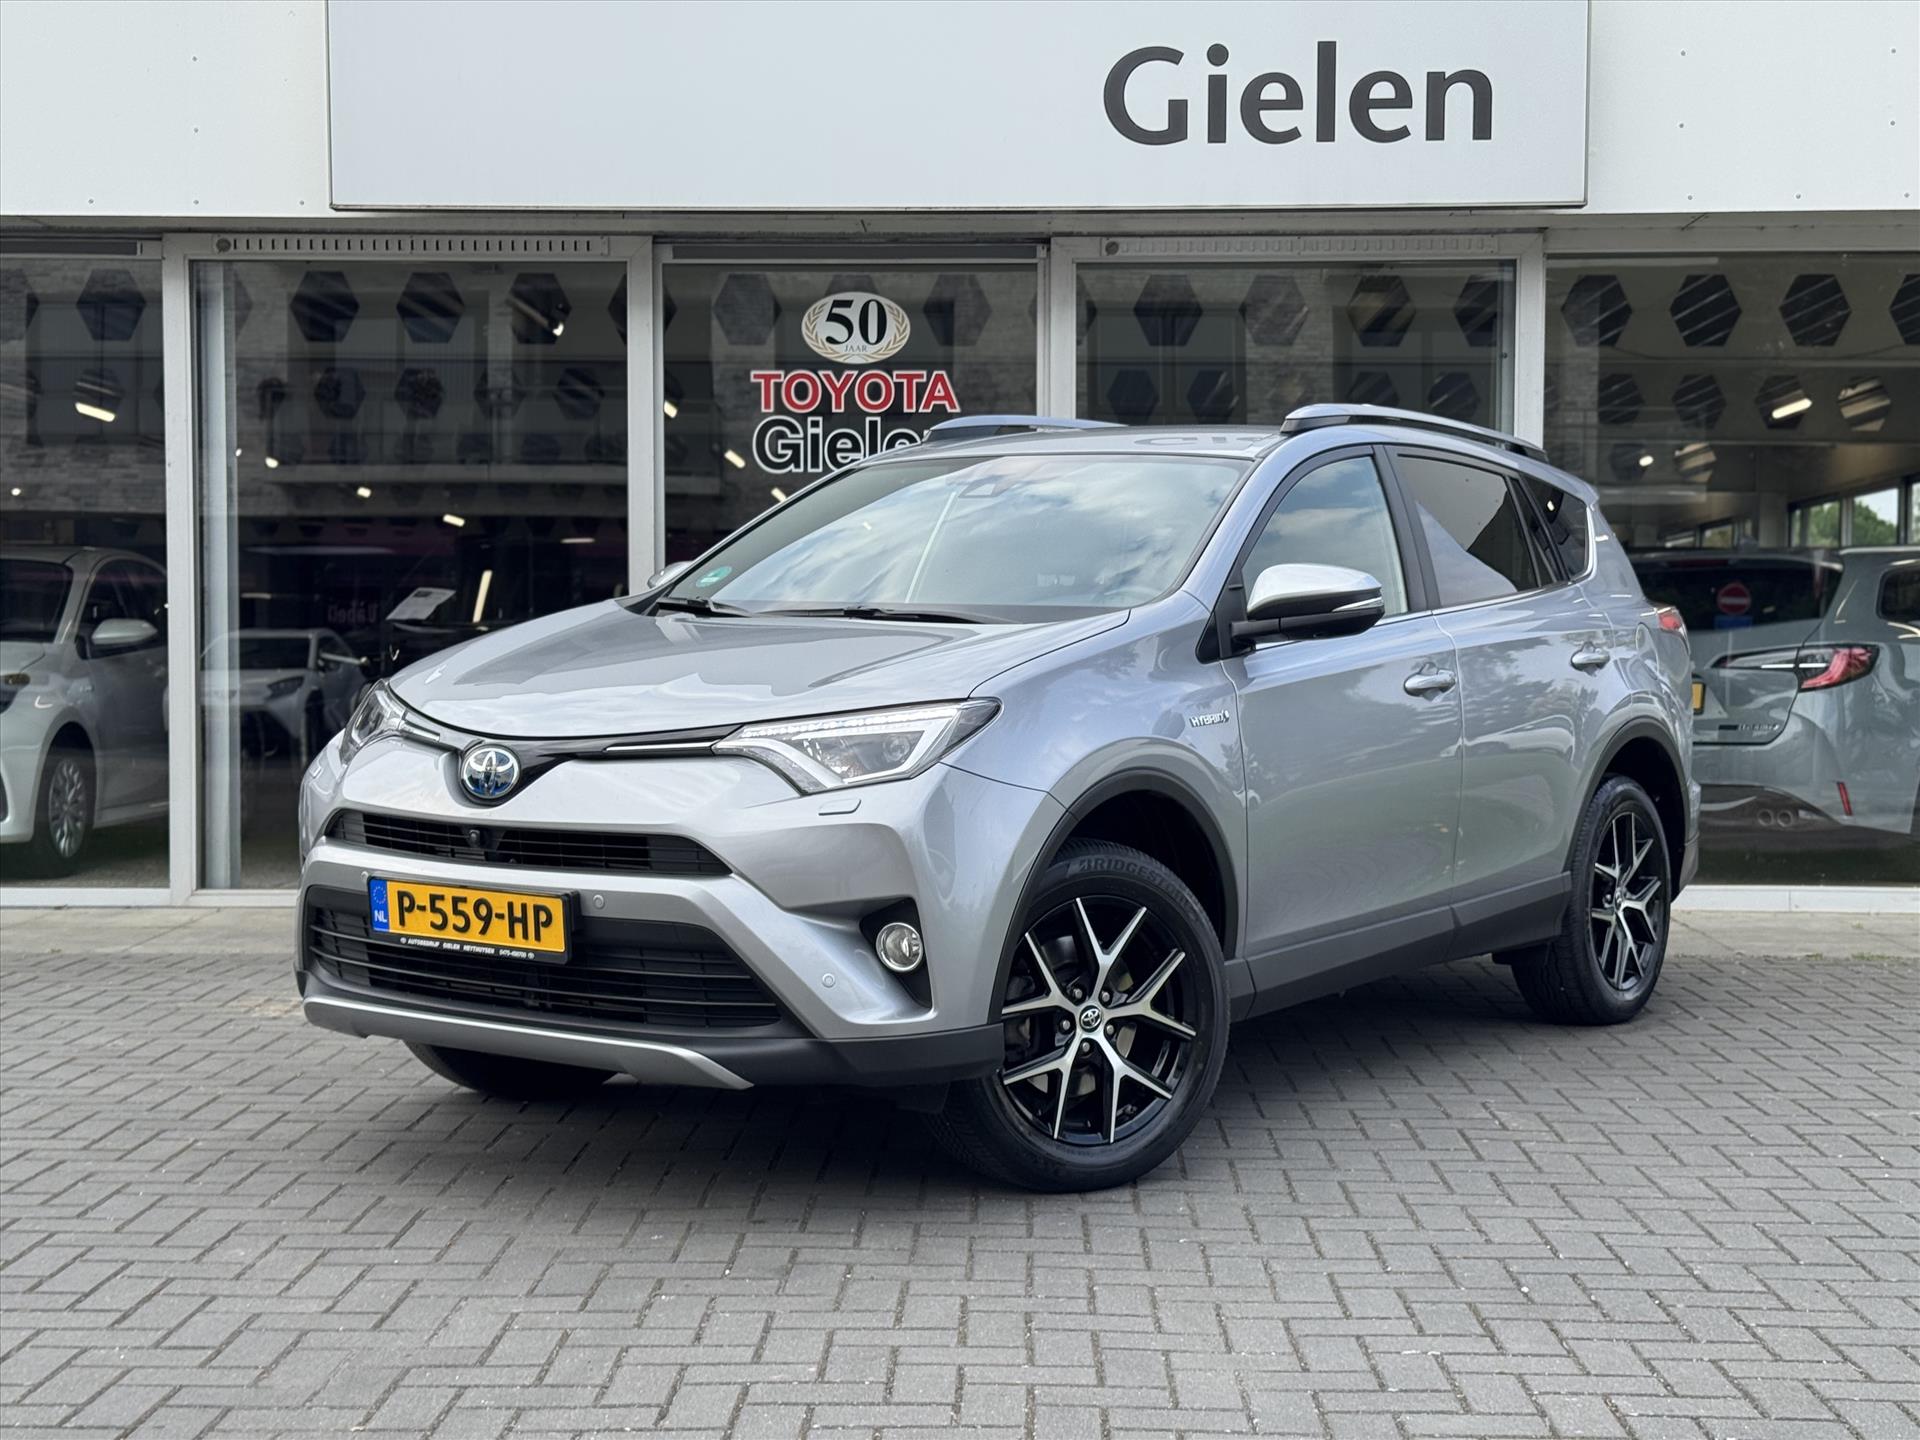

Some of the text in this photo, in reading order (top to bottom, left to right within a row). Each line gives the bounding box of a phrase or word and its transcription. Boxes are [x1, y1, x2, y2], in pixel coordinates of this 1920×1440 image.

[1103, 40, 1493, 146] Gielen
[825, 298, 888, 346] 50
[844, 344, 868, 353] JAAR
[750, 370, 962, 413] TOYOTA
[374, 911, 388, 923] NL
[396, 890, 553, 942] P-559-HP
